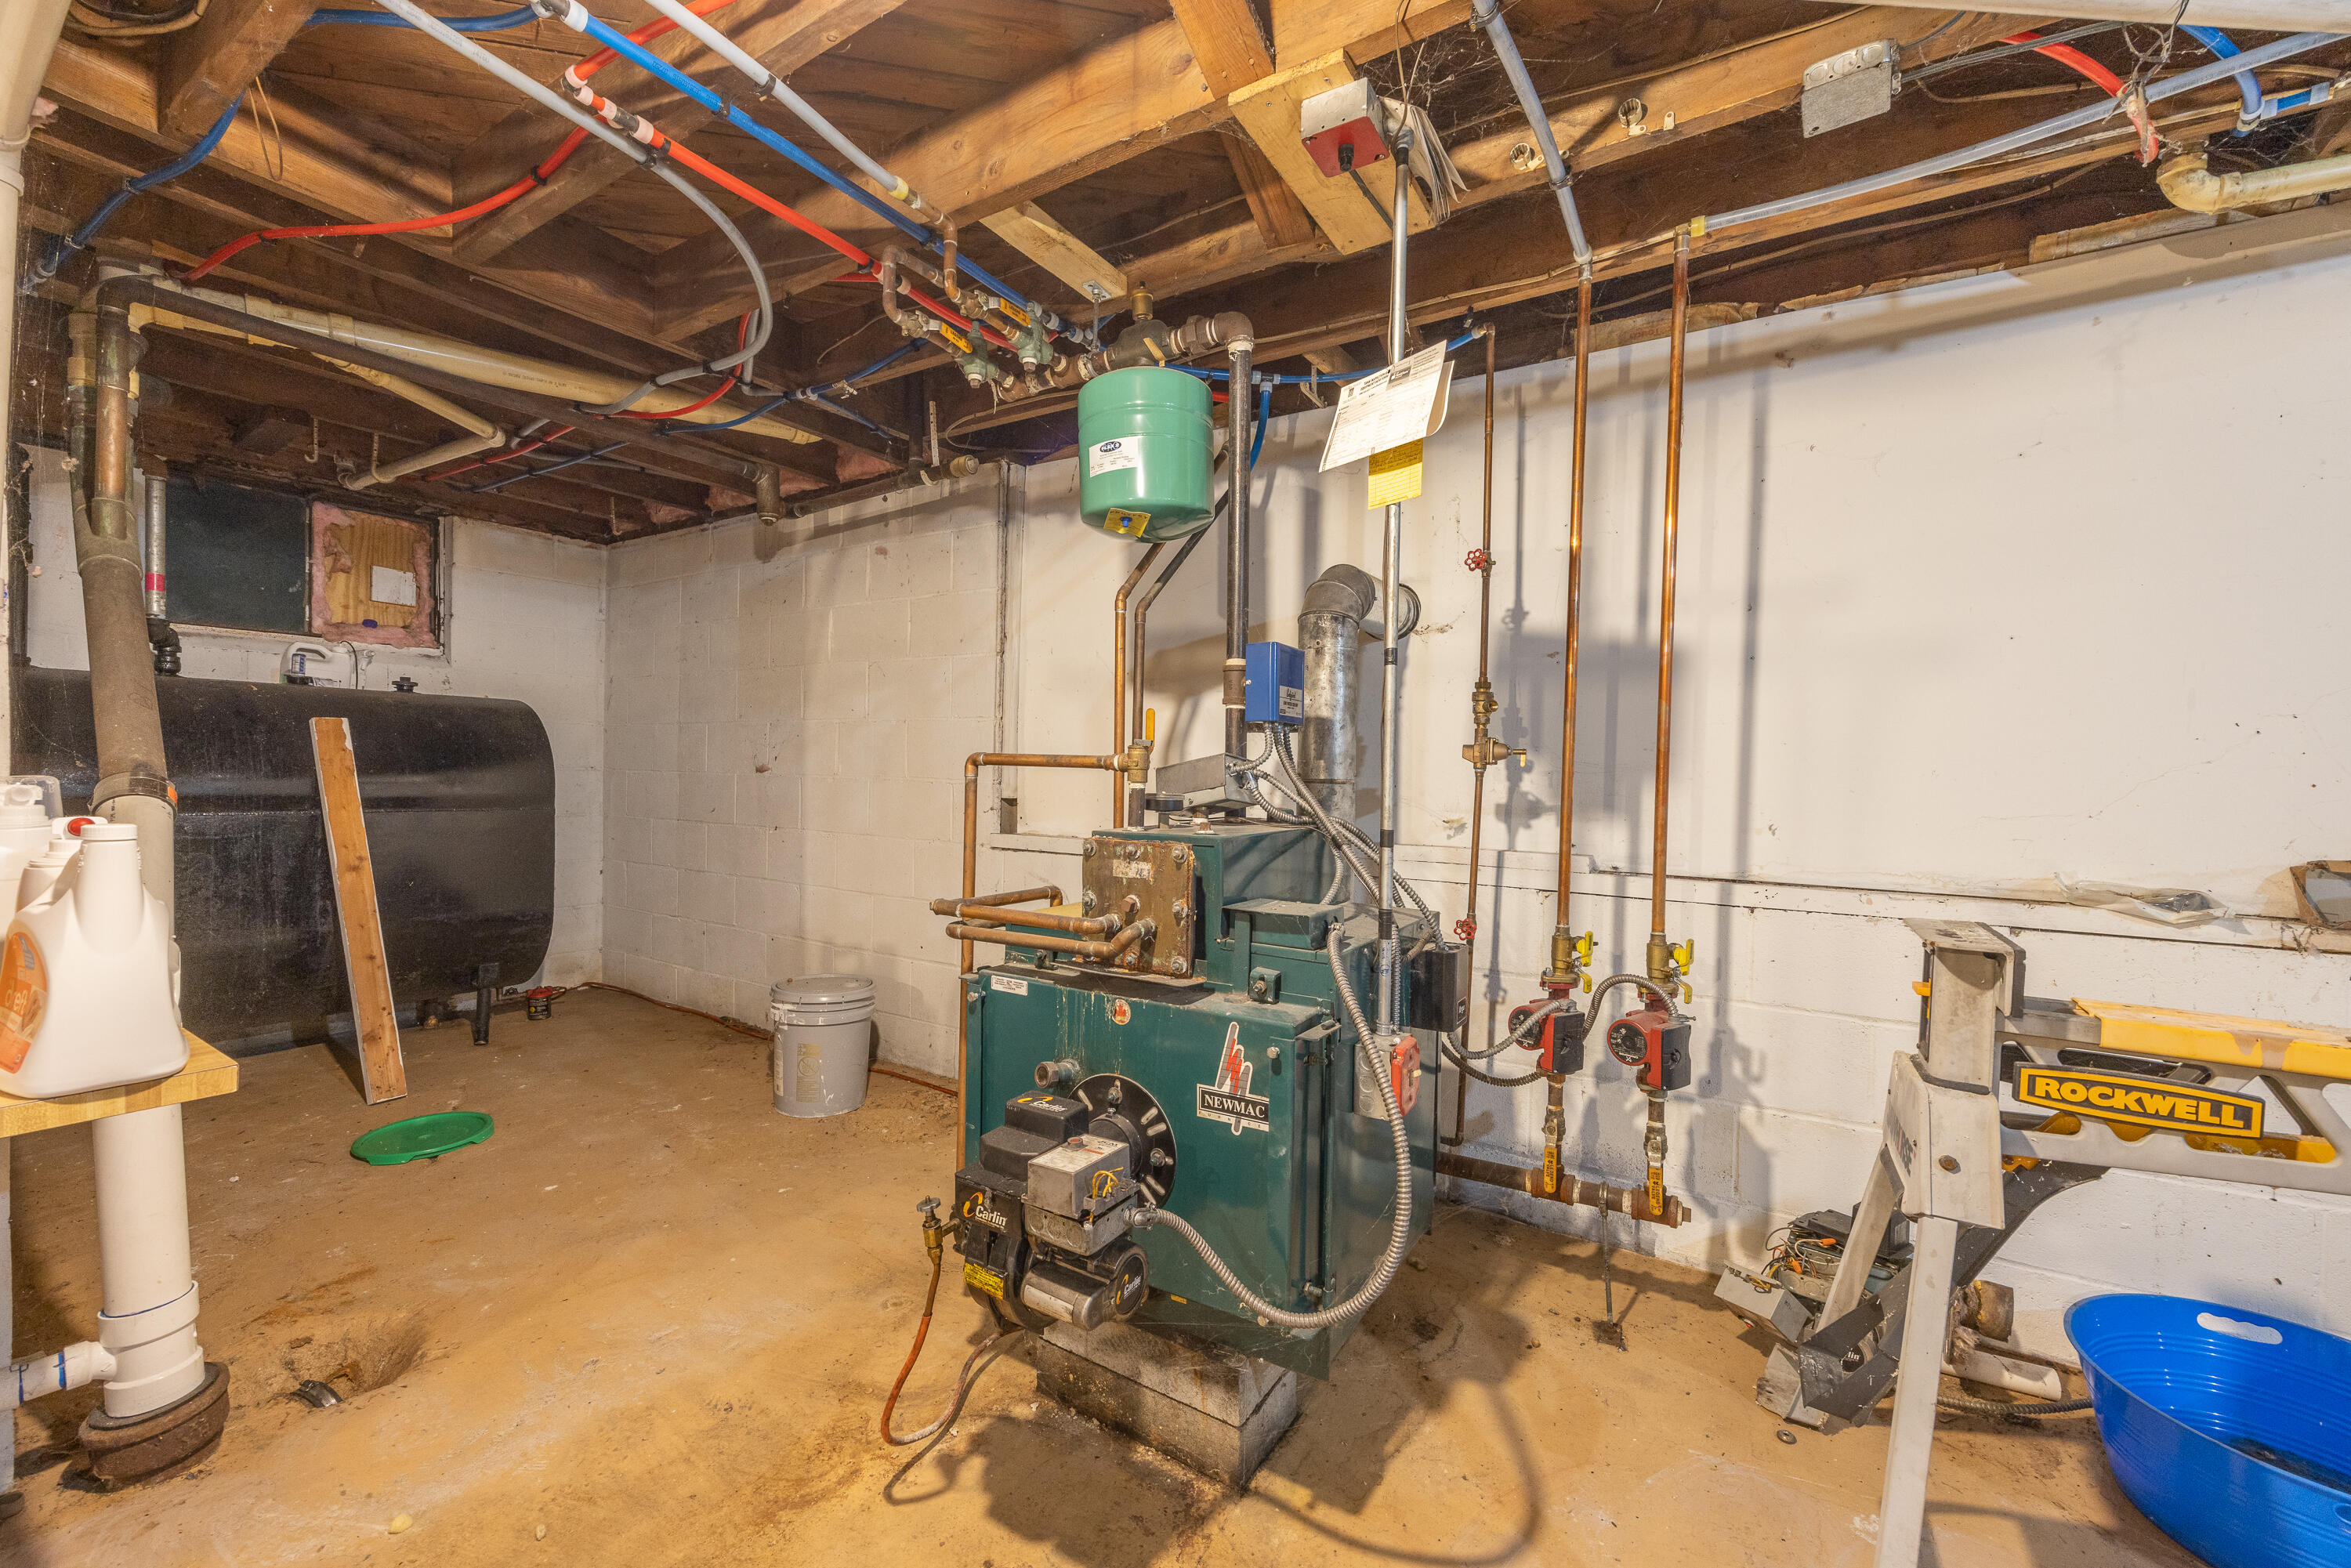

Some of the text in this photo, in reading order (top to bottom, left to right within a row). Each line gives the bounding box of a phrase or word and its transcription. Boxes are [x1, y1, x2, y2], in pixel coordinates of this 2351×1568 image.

[1033, 1100, 1068, 1113] Carlin
[1204, 1094, 1265, 1119] NEWMAC
[2034, 1076, 2244, 1128] ROCKWELL
[1198, 1111, 1261, 1128] FURNACE
[976, 1204, 1007, 1226] Carlin
[1123, 1275, 1142, 1295] Carlin
